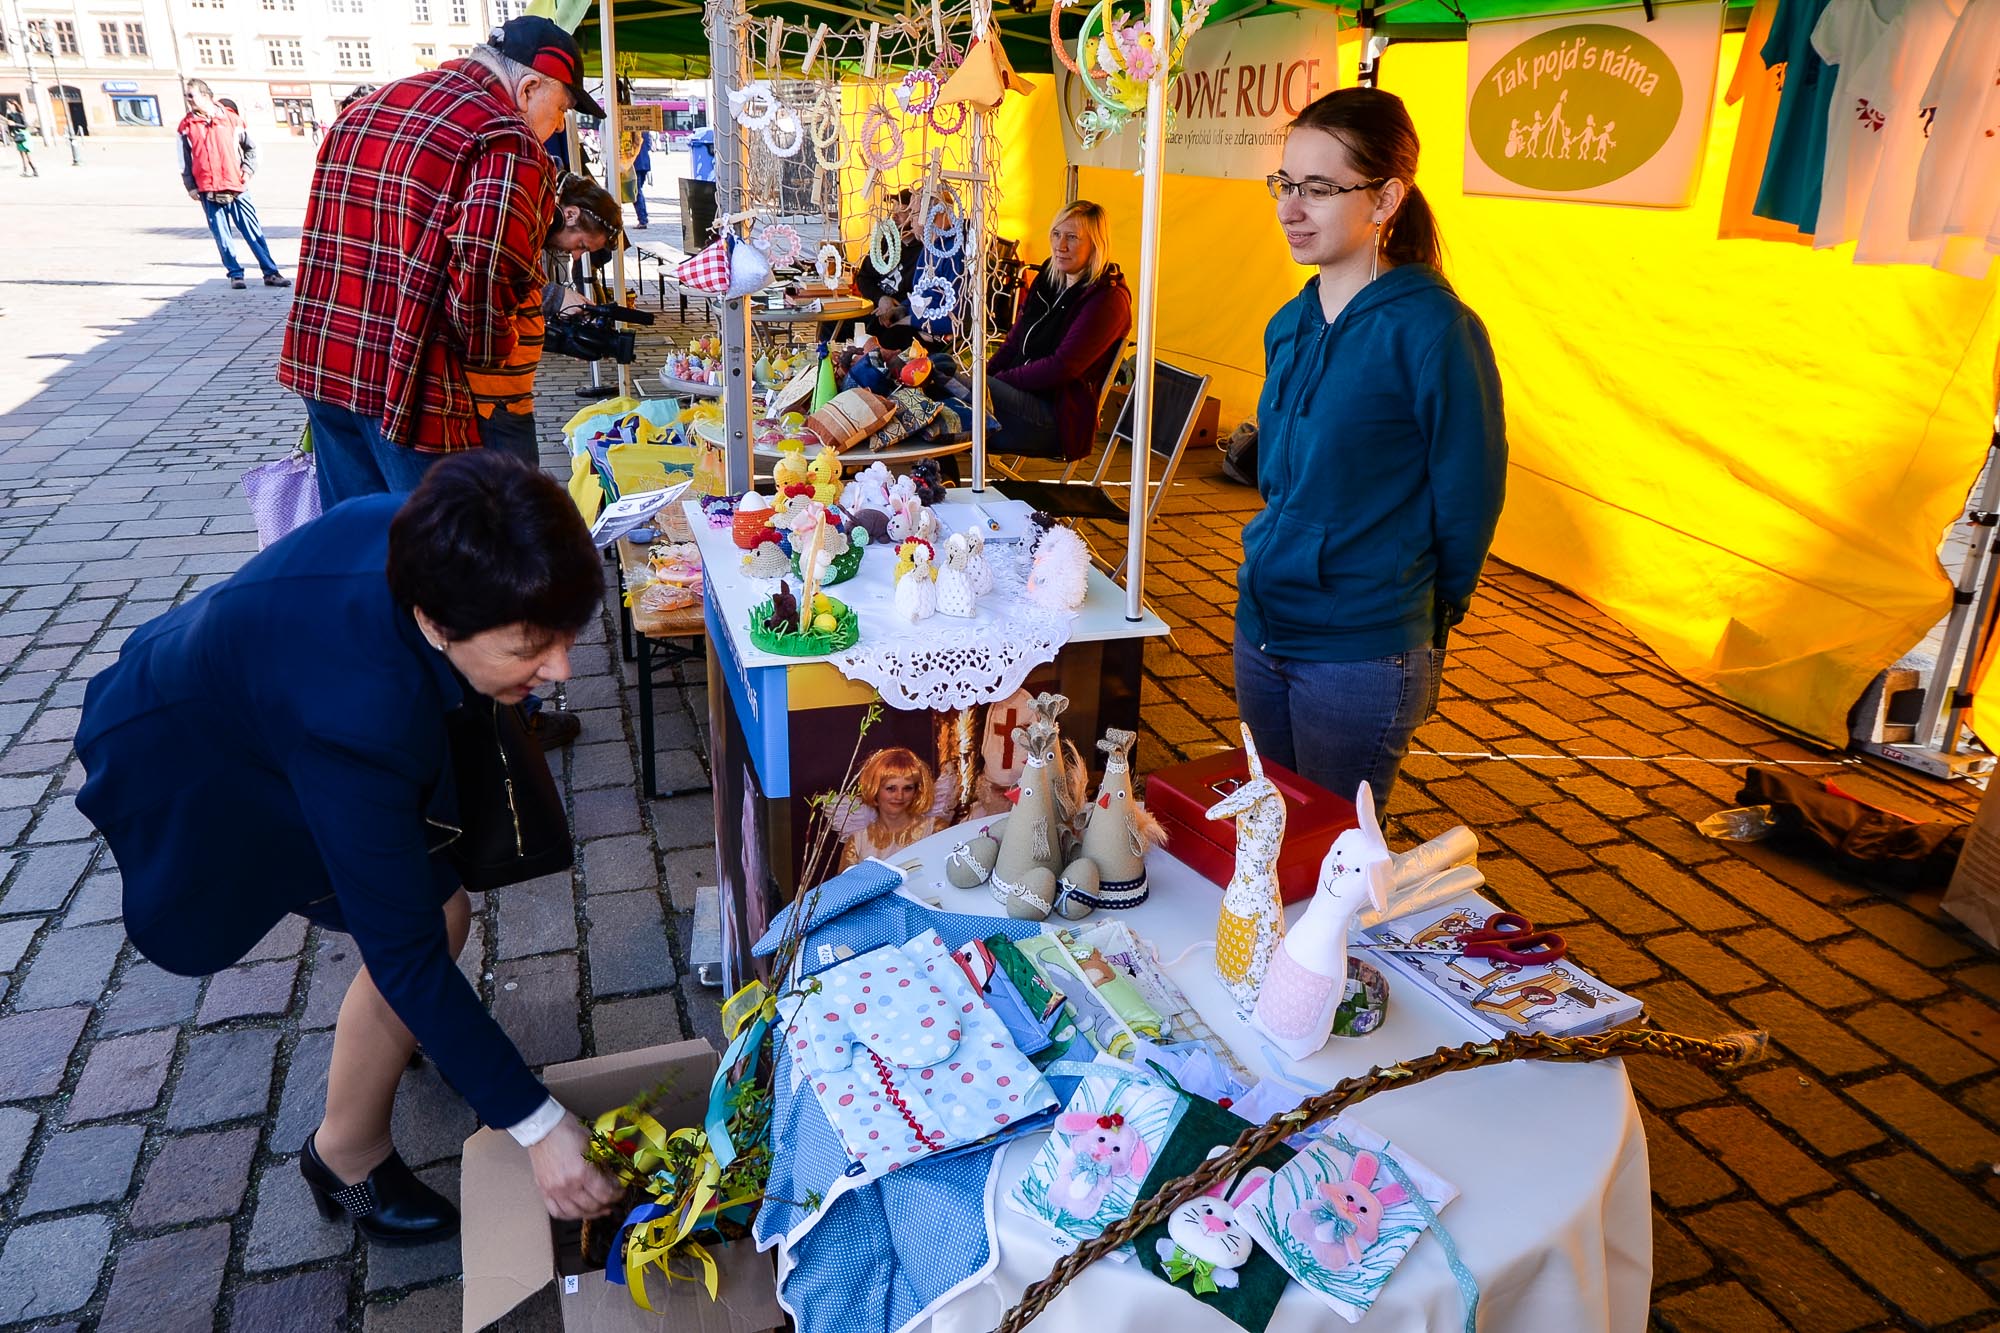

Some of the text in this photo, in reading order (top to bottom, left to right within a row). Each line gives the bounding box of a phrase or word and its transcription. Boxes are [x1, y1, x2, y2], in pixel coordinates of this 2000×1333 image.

[1236, 58, 1320, 118] RUCE
[1491, 56, 1529, 97] Tak
[1533, 37, 1586, 89] pojď
[1599, 45, 1659, 97] náma
[1225, 133, 1233, 145] se
